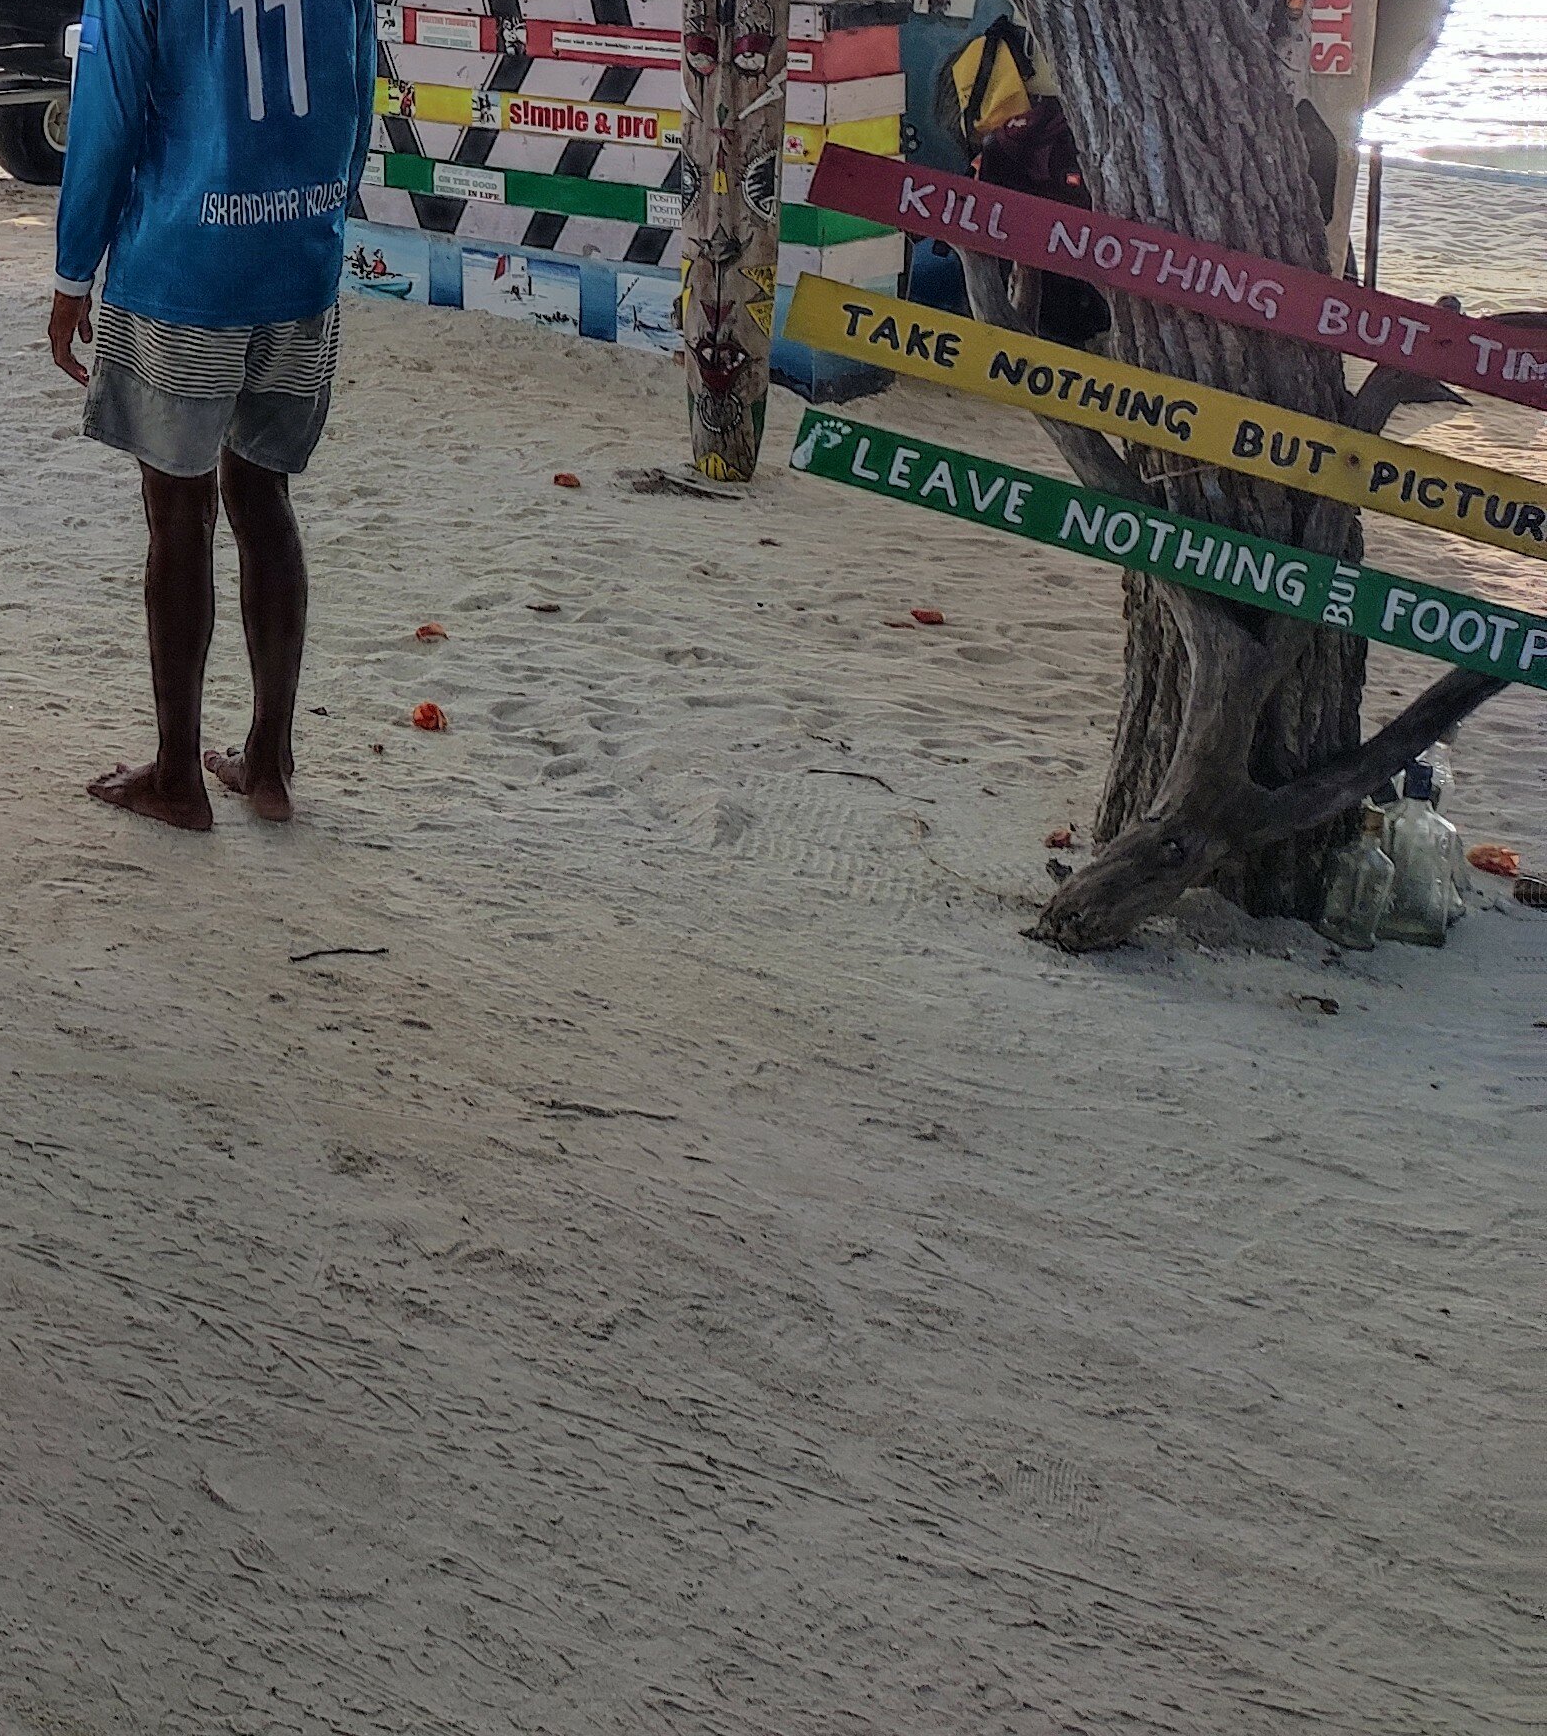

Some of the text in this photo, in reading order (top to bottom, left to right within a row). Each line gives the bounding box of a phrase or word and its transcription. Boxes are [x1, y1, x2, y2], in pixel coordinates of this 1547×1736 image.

[509, 100, 658, 140] s!mple & pro
[439, 175, 497, 190] ON THE GOOD
[468, 189, 478, 197] IN
[479, 191, 502, 201] LIFE.
[201, 188, 300, 225] ISKANDHAR
[898, 176, 1008, 242] KILL
[1047, 220, 1286, 321] NOTHING
[1317, 296, 1431, 357] BUT
[842, 302, 1547, 542] TAKE NOTHING BUT PICTUR
[850, 437, 1034, 525] LEAVE
[1057, 498, 1308, 608] NOTHING
[1321, 560, 1361, 628] BUT
